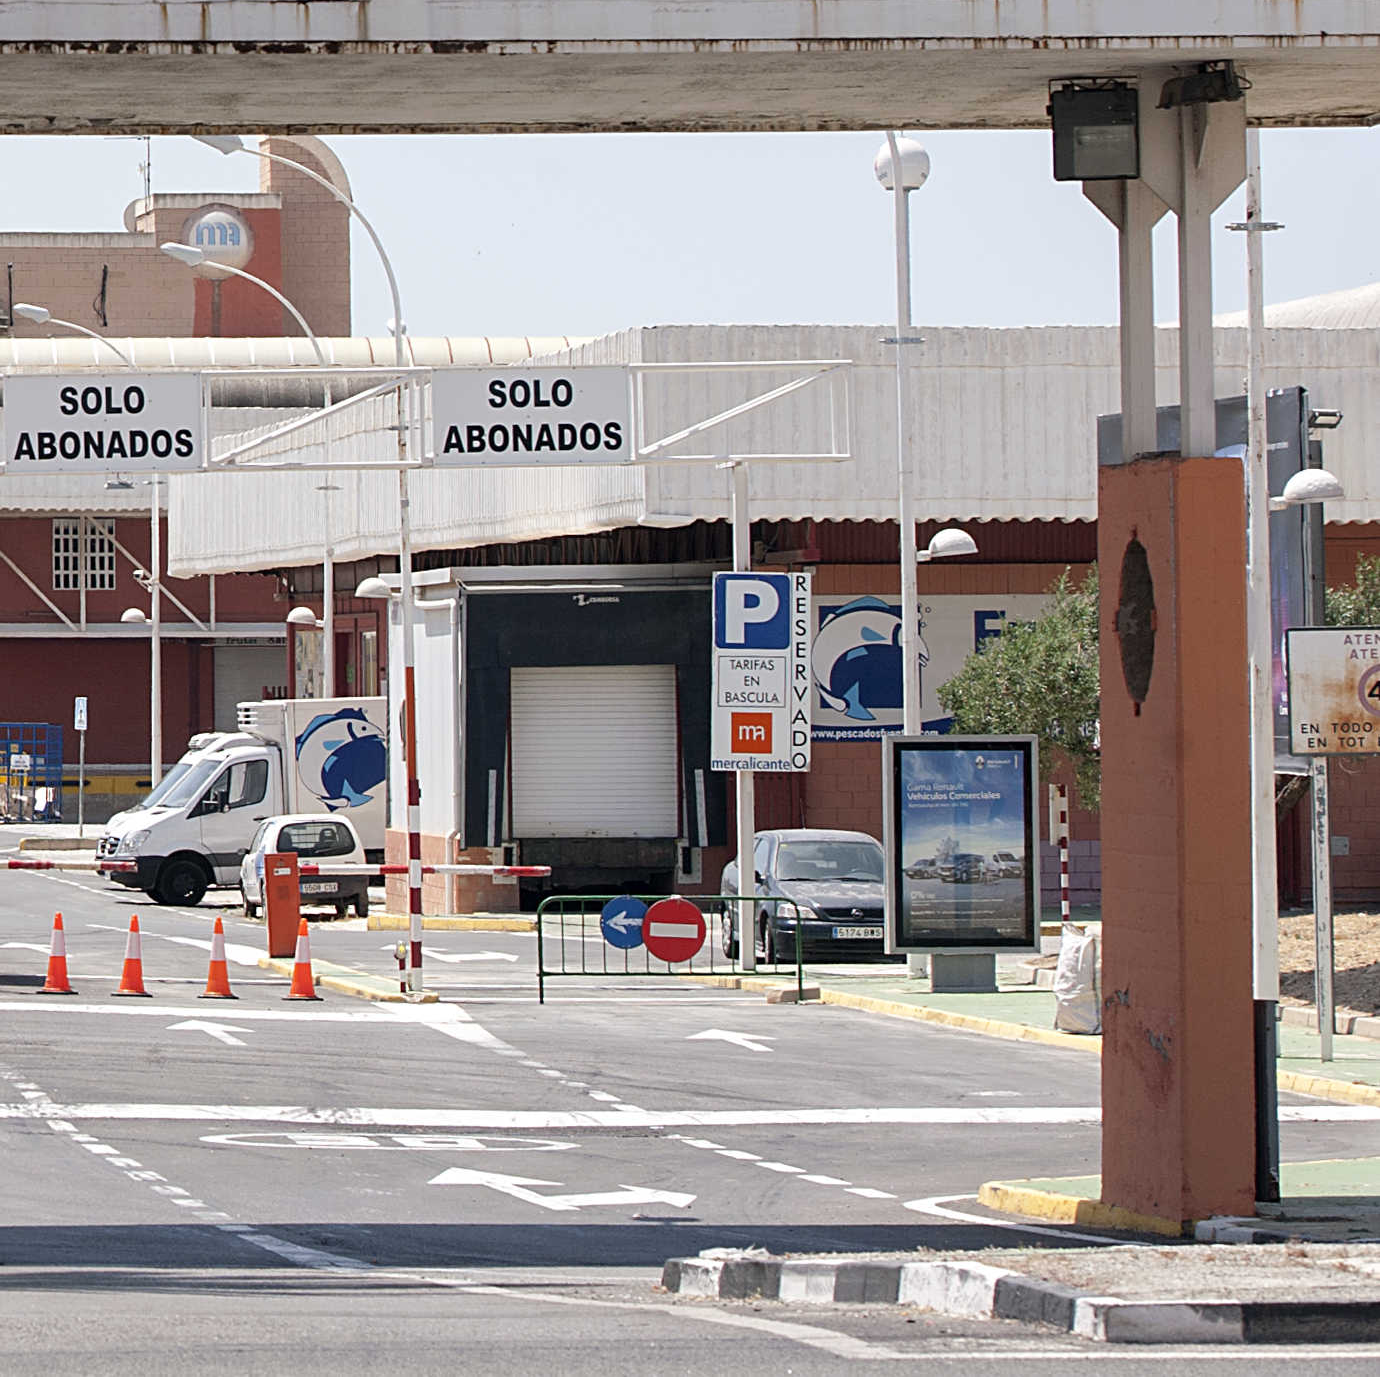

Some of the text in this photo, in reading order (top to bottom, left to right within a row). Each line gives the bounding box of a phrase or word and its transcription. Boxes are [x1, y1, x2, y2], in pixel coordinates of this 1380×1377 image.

[60, 386, 145, 415] SOLO
[488, 379, 573, 408] SOLO
[14, 429, 193, 460] ABONADOS
[443, 422, 622, 453] ABONADOS
[725, 579, 780, 644] P
[730, 659, 775, 671] TARIFAS
[792, 575, 808, 769] RESERVADO
[744, 676, 760, 687] EN
[725, 692, 780, 704] BASCULA
[1301, 722, 1373, 734] EN TODO
[1307, 738, 1327, 749] EN
[1338, 737, 1365, 748] TOT
[711, 757, 791, 770] mercalicante
